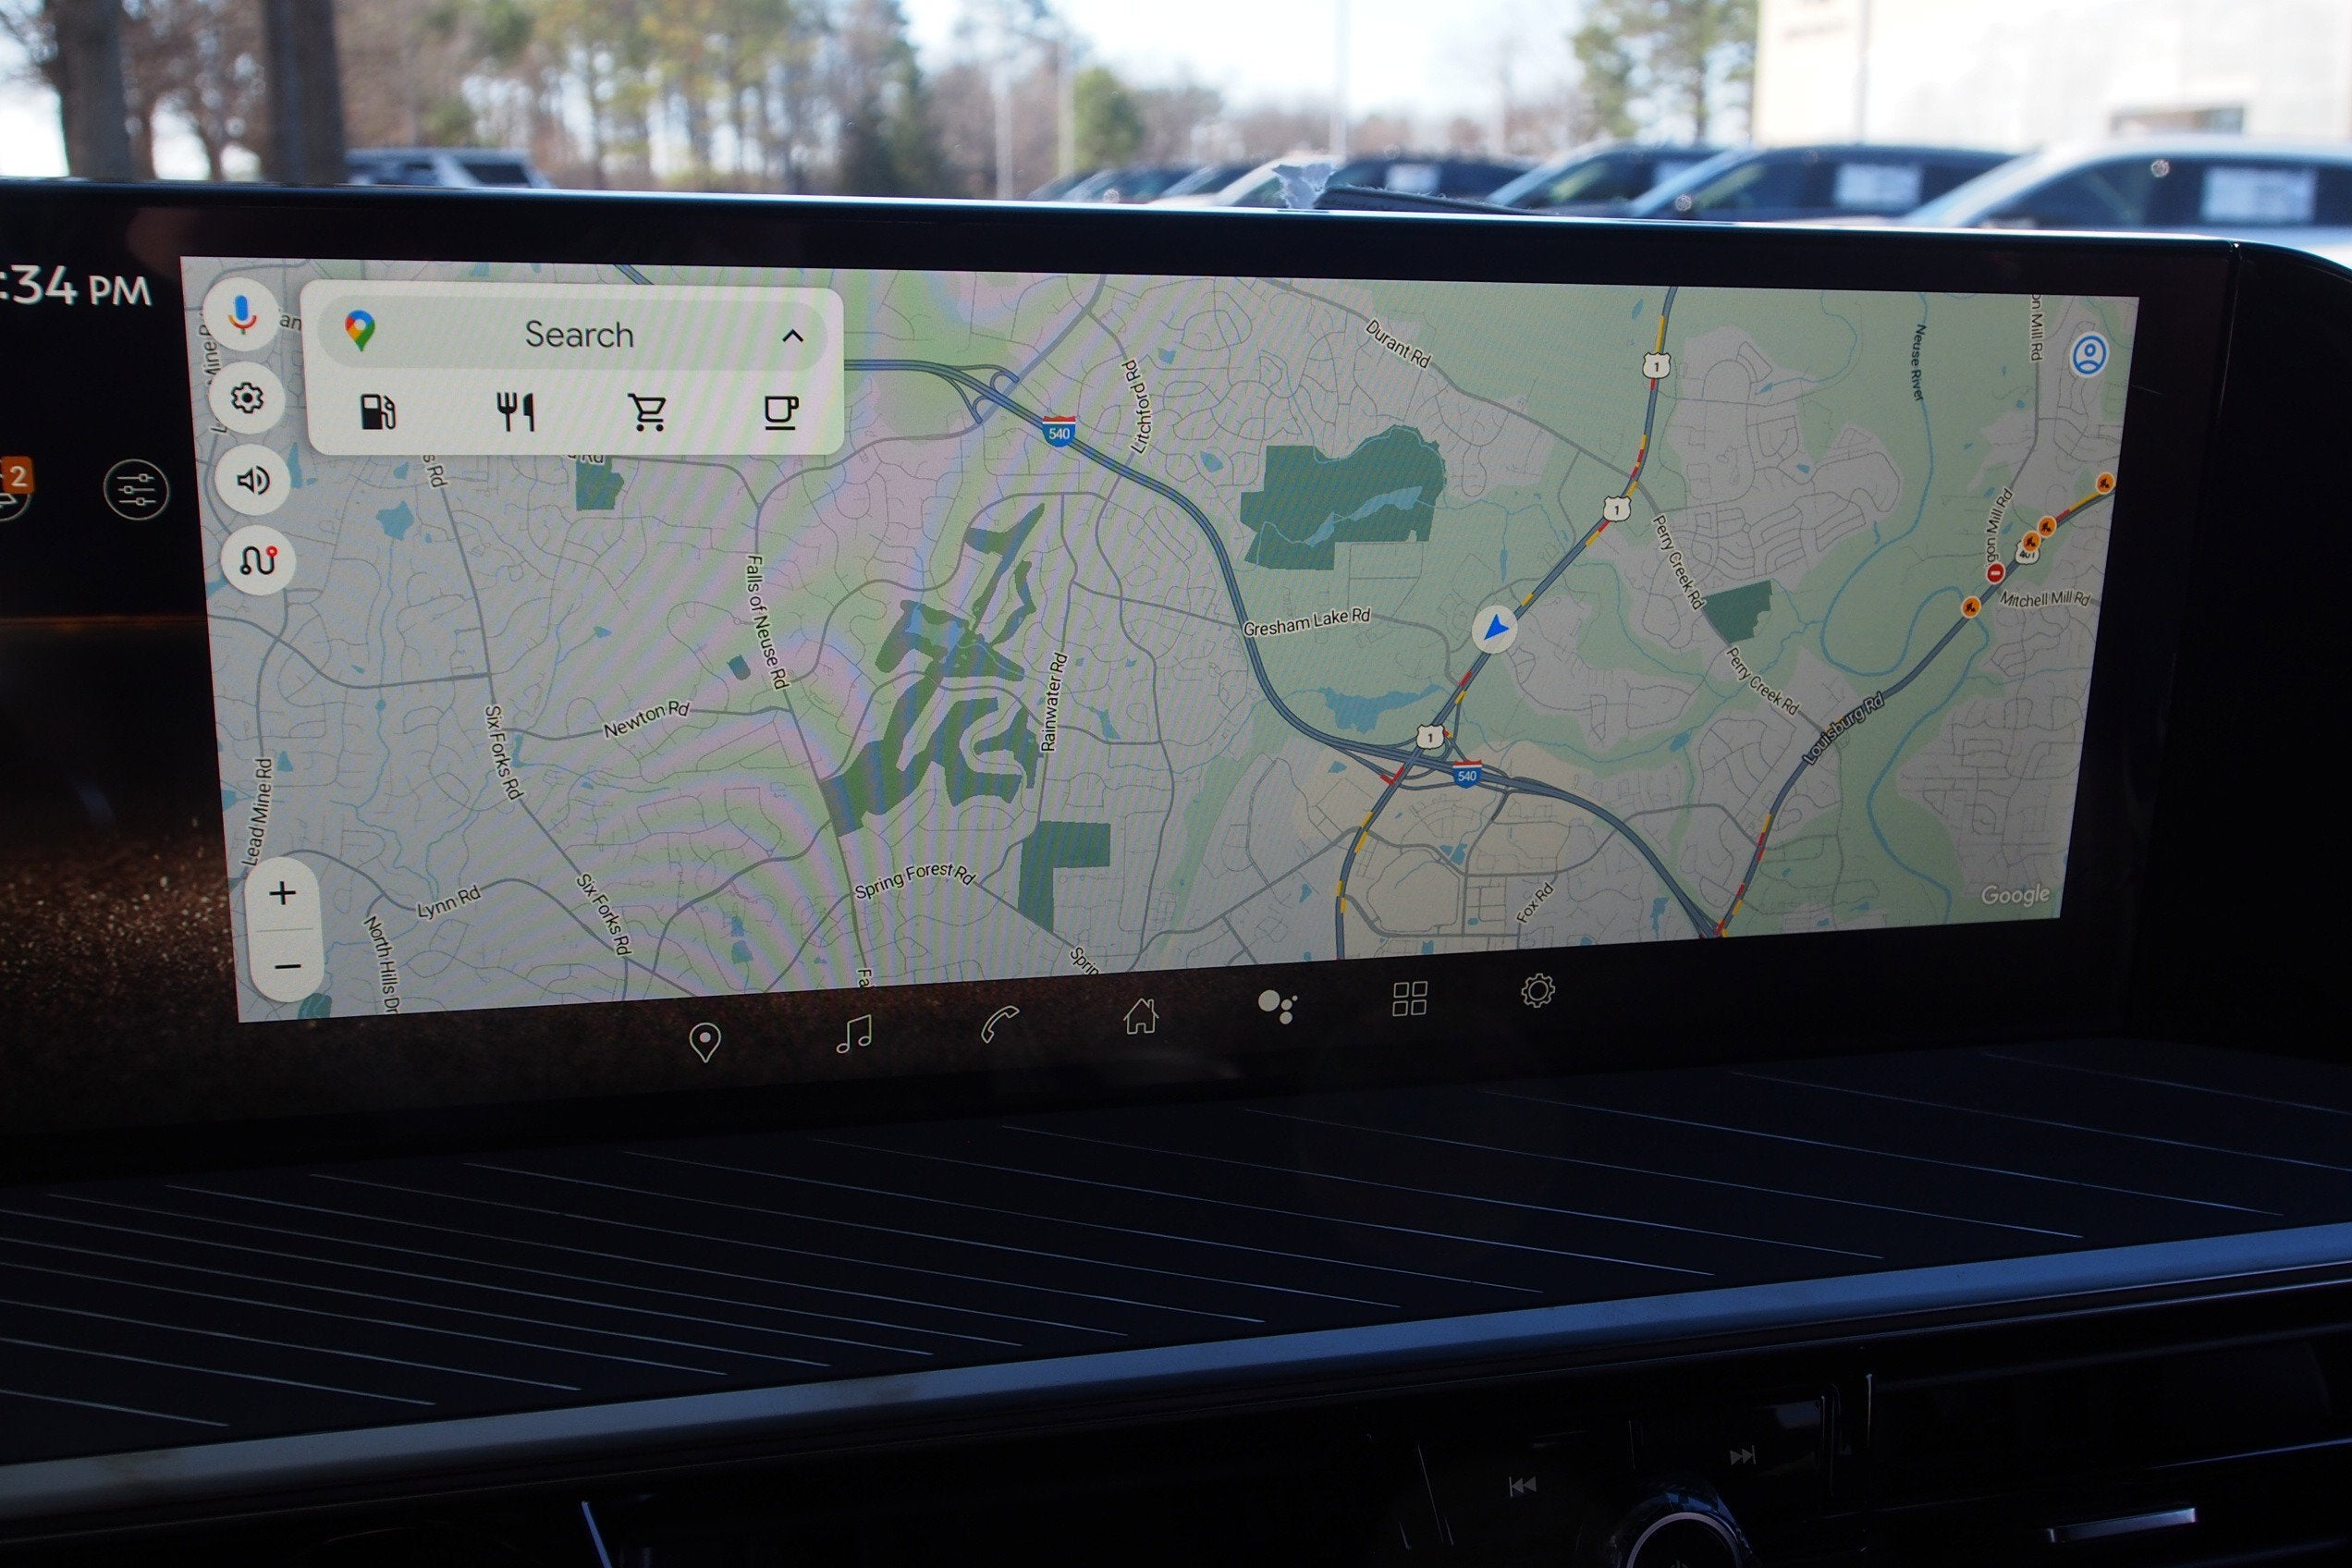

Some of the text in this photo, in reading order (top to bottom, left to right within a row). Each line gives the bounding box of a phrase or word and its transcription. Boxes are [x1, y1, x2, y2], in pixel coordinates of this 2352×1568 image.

[89, 275, 153, 306] PM
[525, 319, 634, 348] Search
[1366, 320, 1432, 369] Durant Rd
[2031, 313, 2043, 339] Mill
[1911, 324, 1927, 401] Neuse River
[2031, 343, 2043, 361] Rd
[1121, 359, 1153, 454] Litchford Rd
[1048, 427, 1071, 440] 540
[9, 465, 29, 487] 2
[427, 465, 447, 488] Rd
[1986, 487, 2014, 567] gon Mill Rd
[1653, 515, 1706, 610] Perry Creek Rd
[2000, 590, 2091, 607] Mitchell Mill Rd
[746, 555, 790, 691] Falls of Neuse Rd
[1243, 607, 1371, 636] Gresham Lake Rd
[1726, 647, 1800, 716] Perry Creek Rd
[604, 700, 691, 738] Newton Rd
[1041, 652, 1068, 752] Rainwater Rd
[1802, 691, 1885, 765] Louisburg Rd
[485, 705, 525, 801] Six Forks Rd
[1458, 770, 1477, 782] 540
[241, 758, 273, 866] Lead Mine Rd
[855, 863, 977, 900] Spring Forest Rd
[1981, 883, 2051, 908] Google
[418, 884, 482, 920] Lynn Rd
[576, 874, 632, 956] Six Forks Rd
[1516, 881, 1554, 924] Fox Rd
[363, 915, 400, 1014] North Hills Dr
